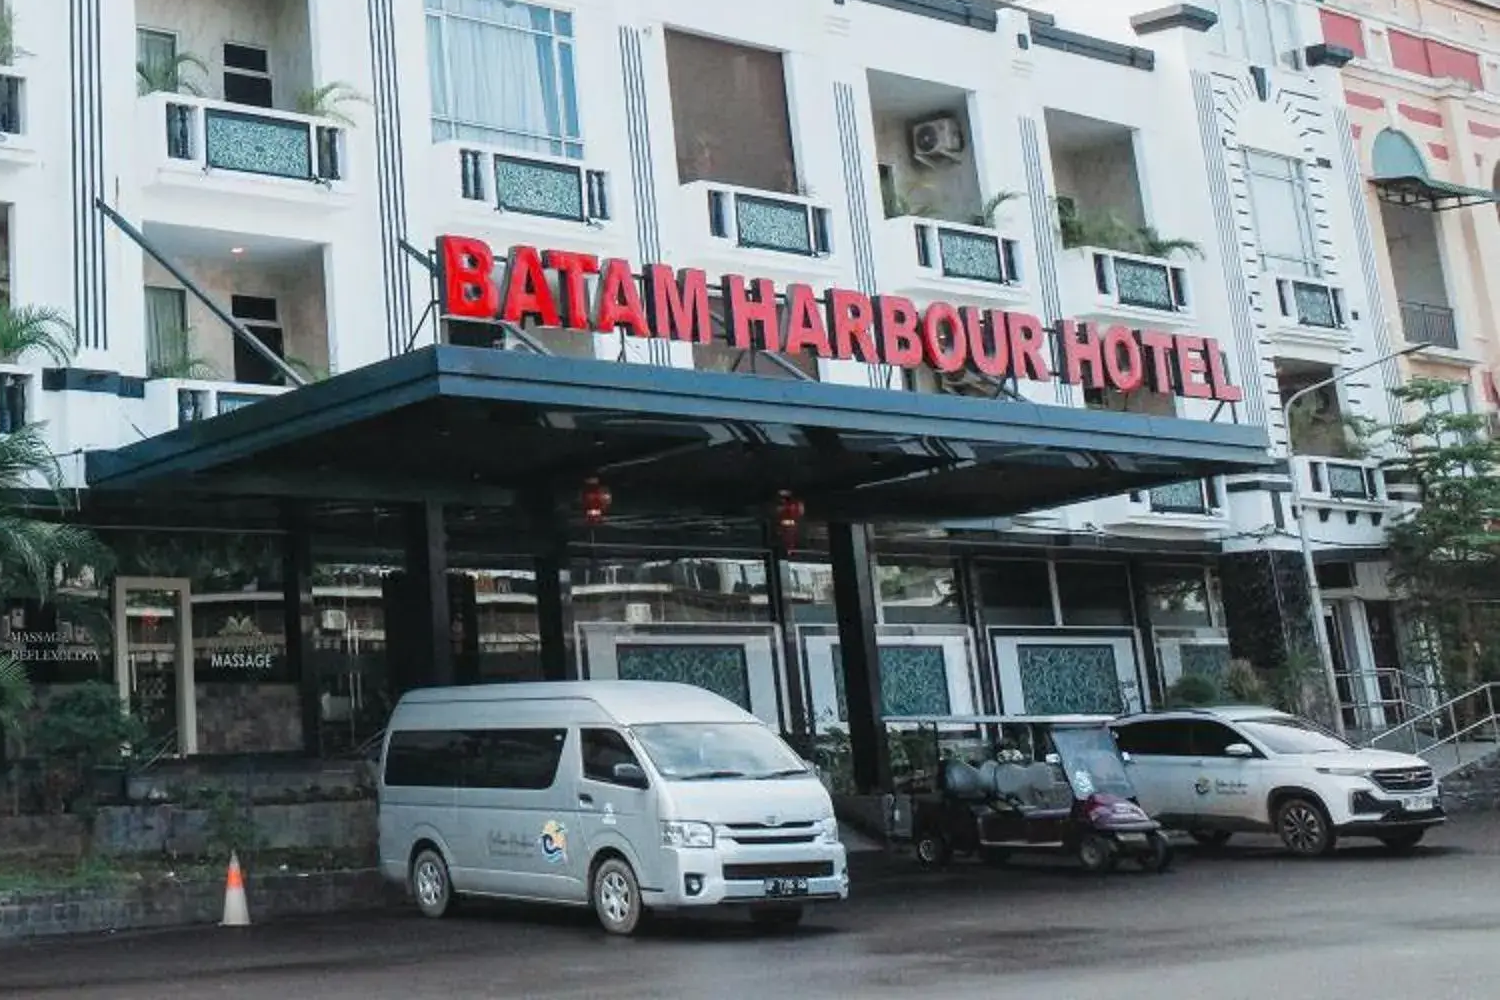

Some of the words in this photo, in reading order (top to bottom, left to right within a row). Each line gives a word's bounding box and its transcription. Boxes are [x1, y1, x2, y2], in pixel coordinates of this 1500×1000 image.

[437, 233, 714, 347] BATAM
[722, 273, 1052, 382] HARBOUR
[1055, 318, 1244, 403] HOTEL
[210, 652, 273, 669] MASSAGE
